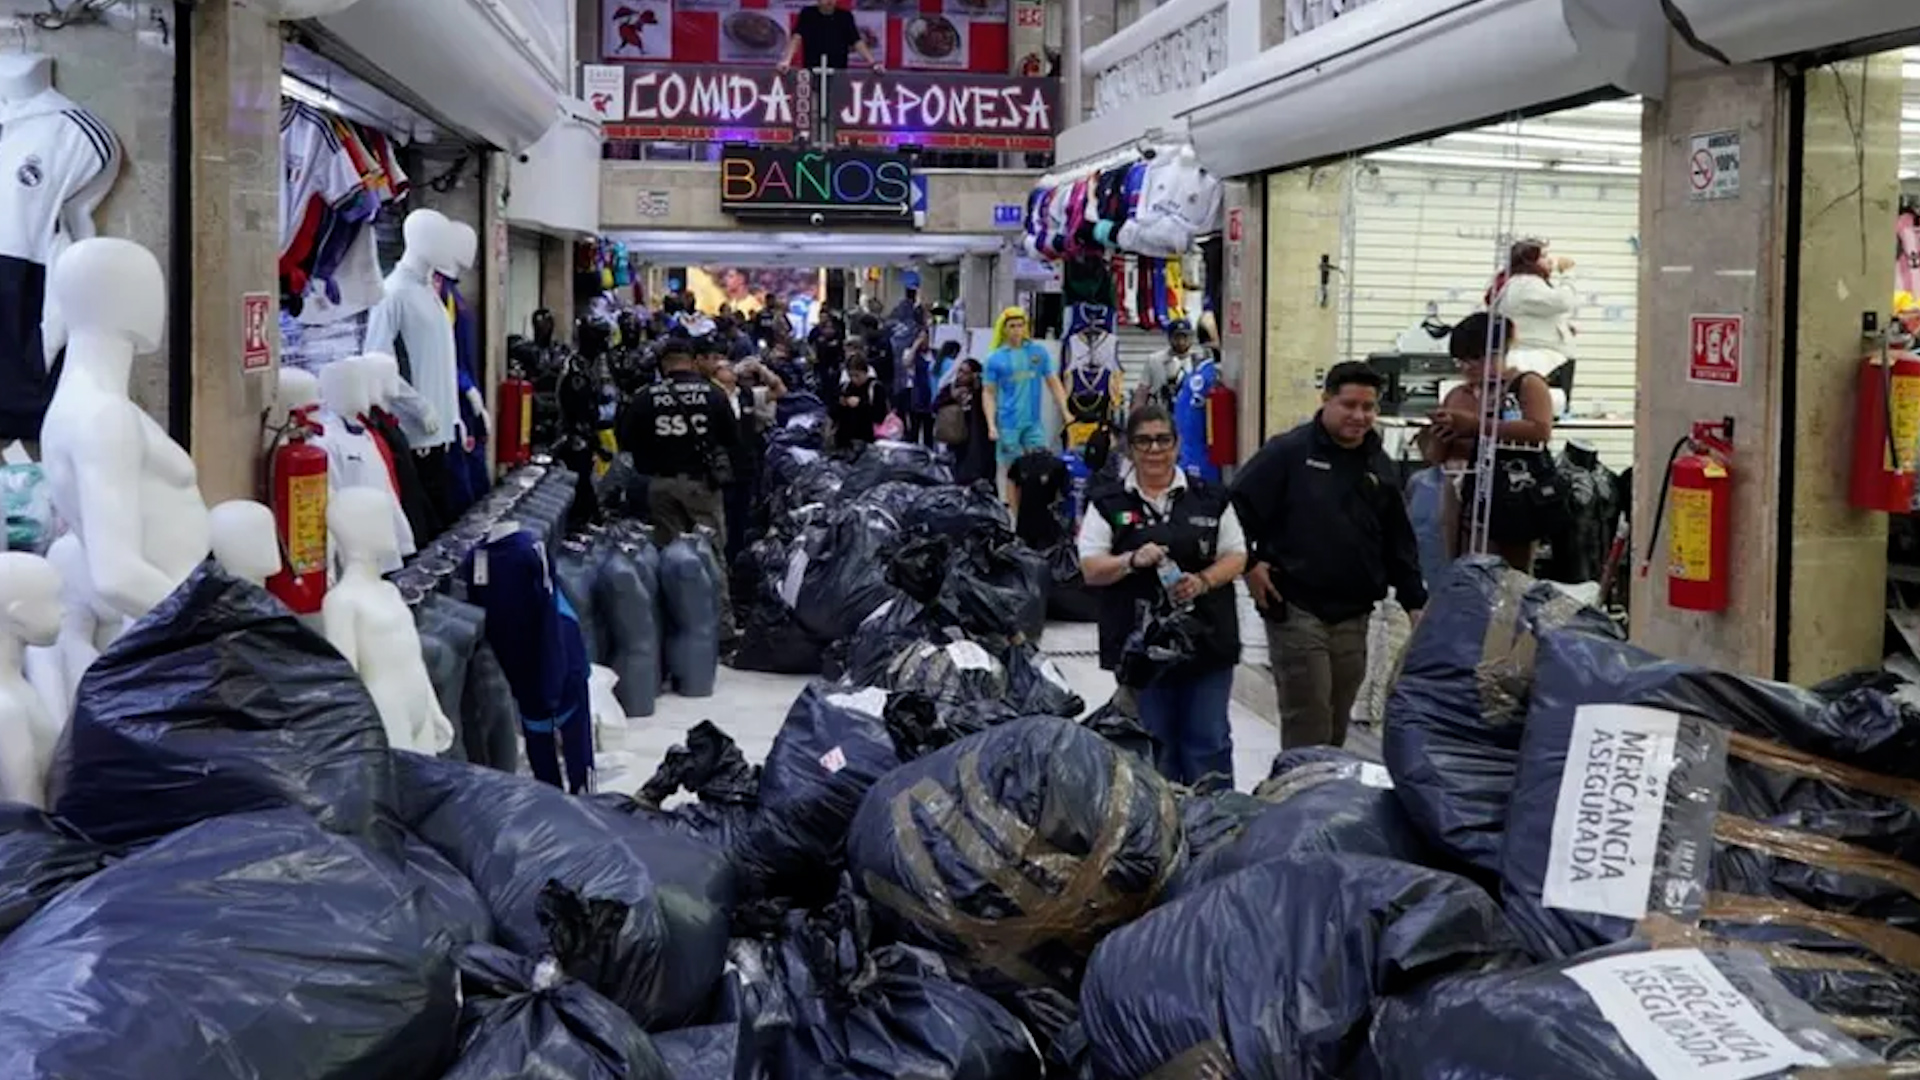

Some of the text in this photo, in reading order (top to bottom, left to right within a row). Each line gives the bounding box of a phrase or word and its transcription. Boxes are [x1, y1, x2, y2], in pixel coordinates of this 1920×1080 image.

[629, 71, 792, 122] COMIDA
[840, 81, 1050, 129] JAPONESA
[722, 153, 909, 202] BAÑOS
[1570, 729, 1614, 882] ASEGURADA
[1599, 730, 1649, 880] MERCANCÍA
[1613, 968, 1729, 1067] ASEGURADA
[1653, 964, 1774, 1063] MERCANCÍA
